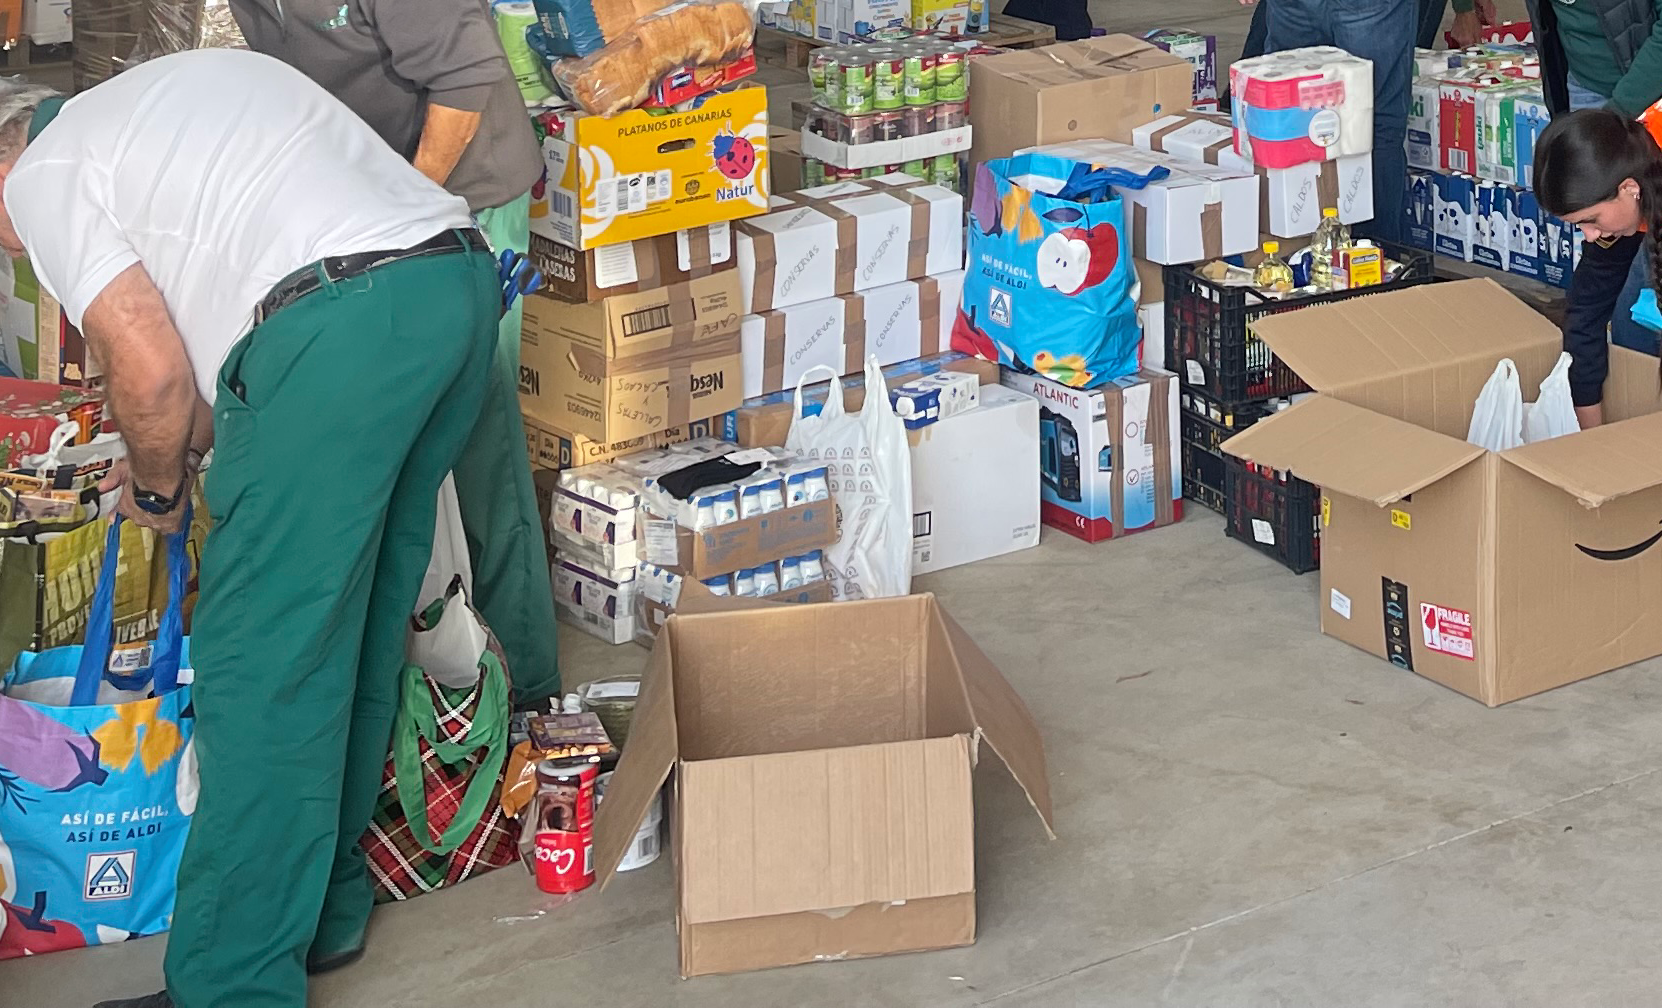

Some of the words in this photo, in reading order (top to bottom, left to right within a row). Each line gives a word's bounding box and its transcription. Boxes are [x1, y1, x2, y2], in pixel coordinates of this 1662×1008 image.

[617, 118, 668, 137] PLATANOS
[669, 117, 682, 129] DE
[684, 108, 732, 126] CANARIAS
[716, 183, 755, 201] Natur
[1290, 176, 1313, 225] CALDOS
[1343, 165, 1365, 215] CALDOS
[862, 224, 900, 282] CONSERVAS
[780, 244, 820, 298] CONSERVAS
[876, 293, 913, 348] CONSERVAS
[789, 315, 836, 366] CONSERVAS
[616, 377, 659, 393] CACAOS
[689, 370, 724, 394] Nesq
[1033, 381, 1080, 410] ATLANTIC
[560, 446, 570, 464] D
[589, 444, 608, 457] C.N.
[1438, 607, 1471, 627] FRAGILE
[60, 810, 90, 825] ASÍ
[94, 813, 115, 825] DE
[121, 804, 169, 824] FÁCIL,
[66, 828, 95, 843] ASÍ
[100, 830, 121, 842] DE
[126, 822, 162, 840] ALDI
[93, 884, 127, 896] ALDI
